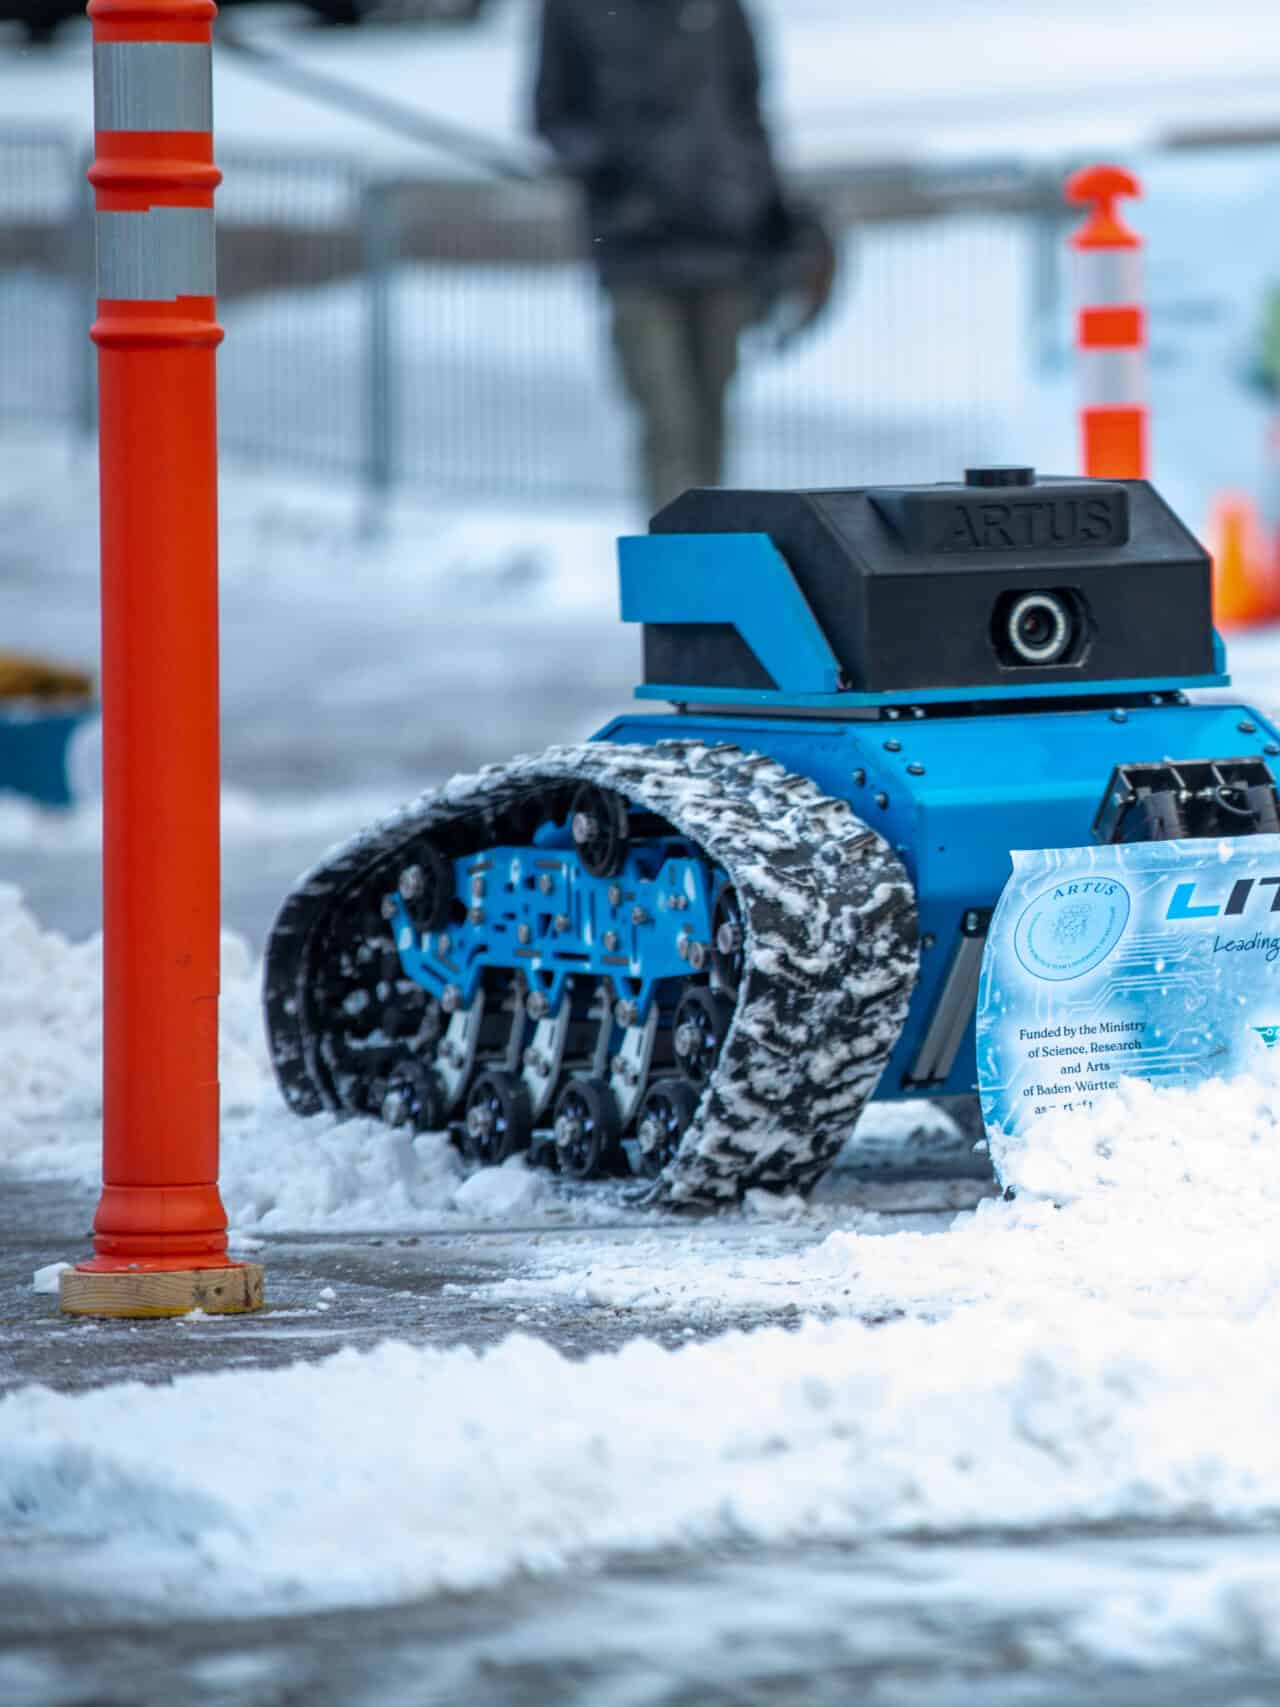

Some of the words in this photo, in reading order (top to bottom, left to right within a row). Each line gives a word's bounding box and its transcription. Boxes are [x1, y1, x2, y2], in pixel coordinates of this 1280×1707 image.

[943, 499, 1113, 549] ARTUS
[1052, 881, 1118, 901] ARTUS
[1019, 1027, 1061, 1041] Funded
[1063, 1025, 1077, 1038] by
[1079, 1024, 1097, 1035] the
[1099, 1021, 1146, 1034] Ministry
[1028, 1047, 1041, 1058] of
[1042, 1045, 1088, 1057] Science,
[1090, 1039, 1142, 1053] Research
[1060, 1062, 1082, 1075] and
[1086, 1060, 1111, 1073] Arts
[1023, 1085, 1035, 1097] of
